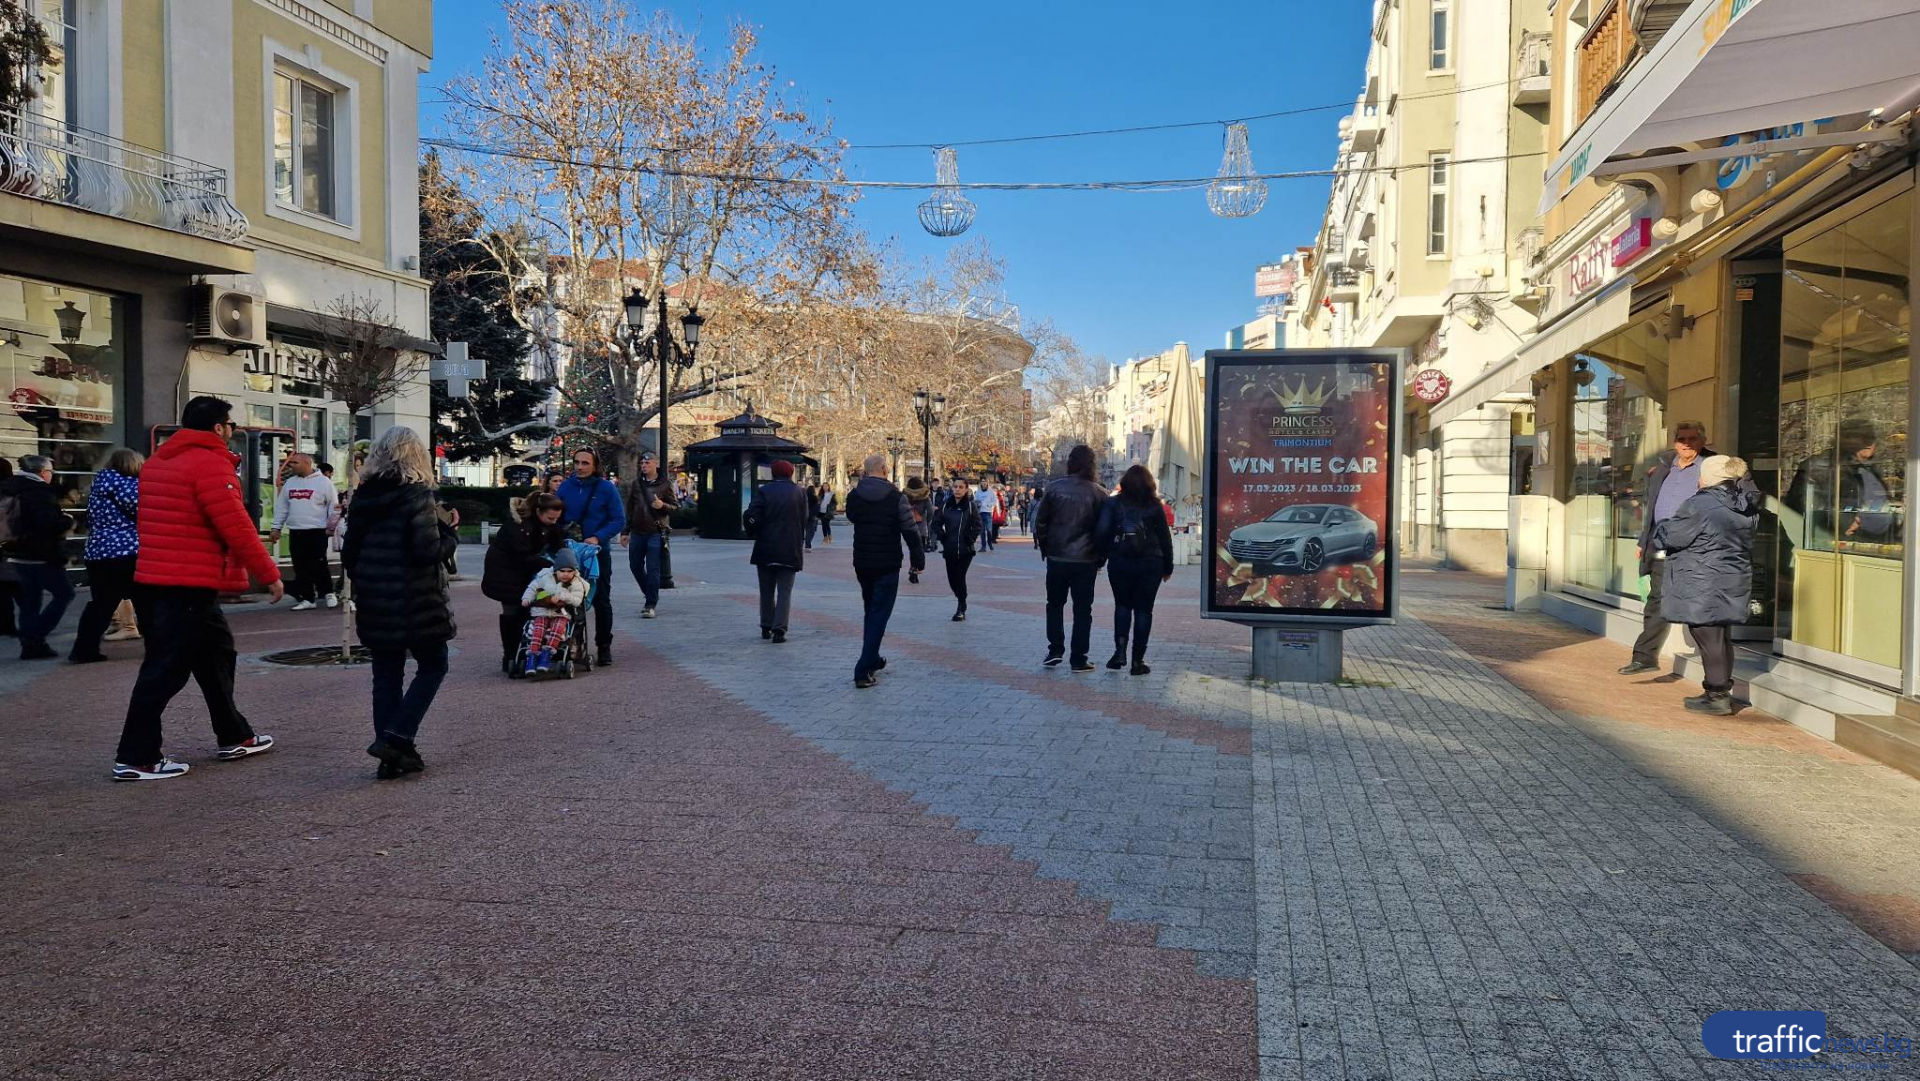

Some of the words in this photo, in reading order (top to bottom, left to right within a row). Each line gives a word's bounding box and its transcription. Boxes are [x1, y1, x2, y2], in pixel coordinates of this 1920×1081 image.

[1569, 234, 1609, 297] Raffy
[243, 348, 339, 383] АПТЕКА
[1272, 416, 1334, 428] PRINCESS
[750, 427, 775, 435] TICKETS
[1273, 438, 1332, 447] TRIMONTIUM
[1228, 456, 1275, 474] WIN
[1281, 456, 1322, 474] THE
[1328, 456, 1378, 474] CAR
[1243, 484, 1296, 493] 17.03.2023
[1306, 484, 1362, 493] 18.03.2023
